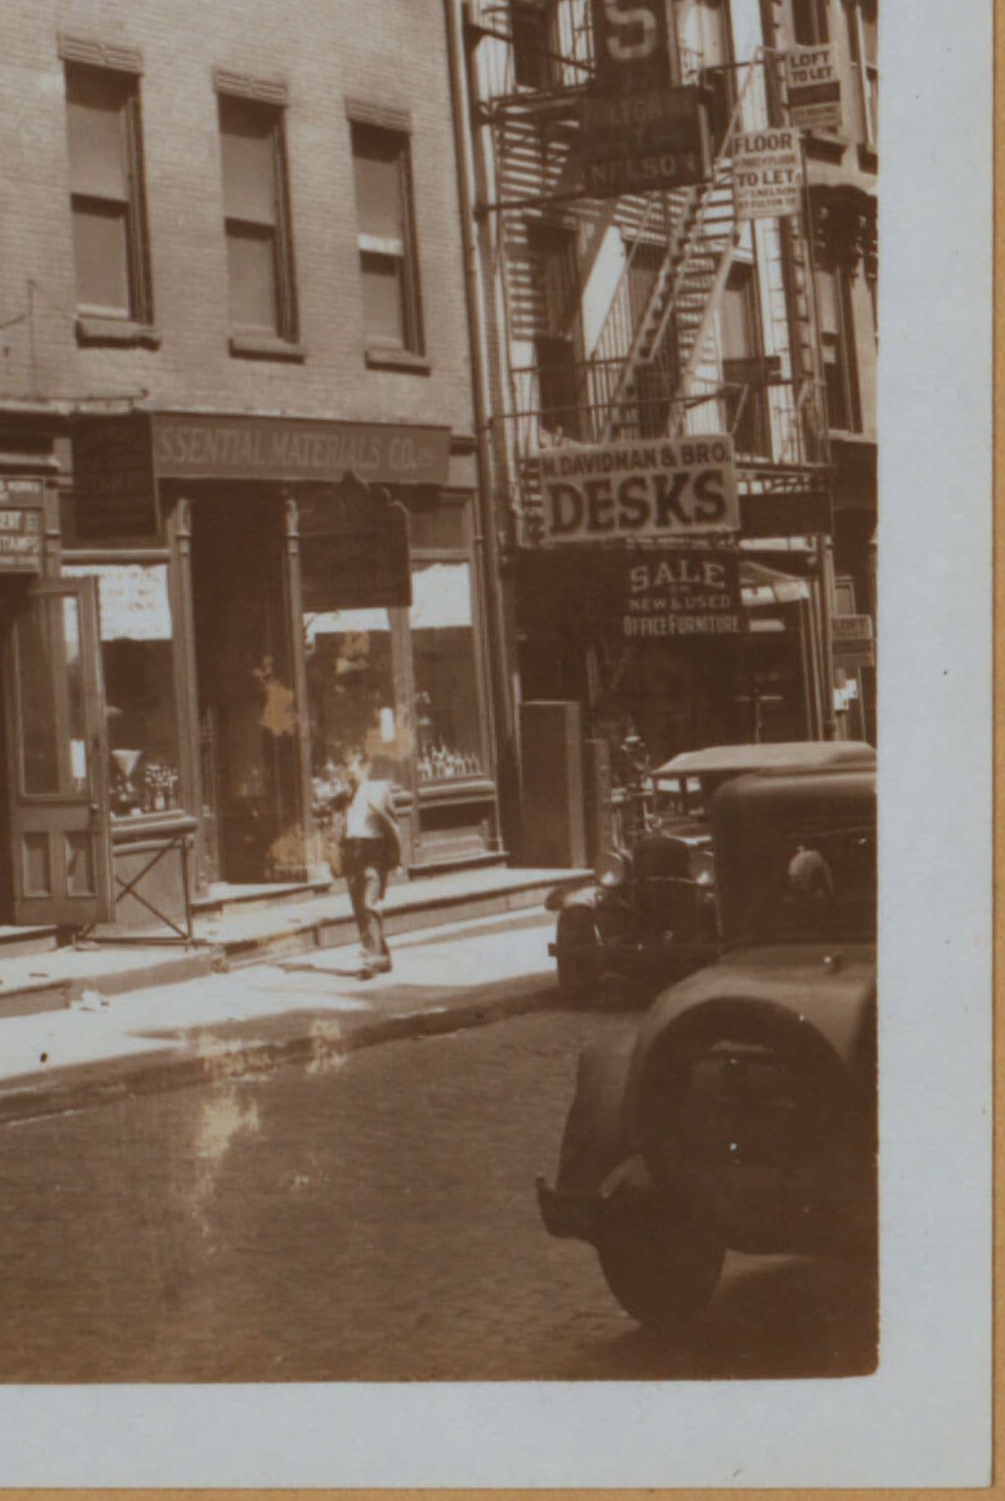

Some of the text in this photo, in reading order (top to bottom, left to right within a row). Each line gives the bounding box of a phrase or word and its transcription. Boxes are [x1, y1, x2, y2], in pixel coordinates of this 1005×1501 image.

[790, 51, 830, 68] LOFT
[790, 66, 832, 82] TO LET
[733, 133, 793, 154] FLOOR
[736, 169, 795, 188] TO LET
[157, 426, 264, 466] SSENTIAL
[274, 431, 381, 470] MATERIALS
[546, 470, 726, 534] DESKS
[630, 559, 725, 594] SALE
[629, 595, 667, 612] NEW
[685, 595, 731, 610] USED
